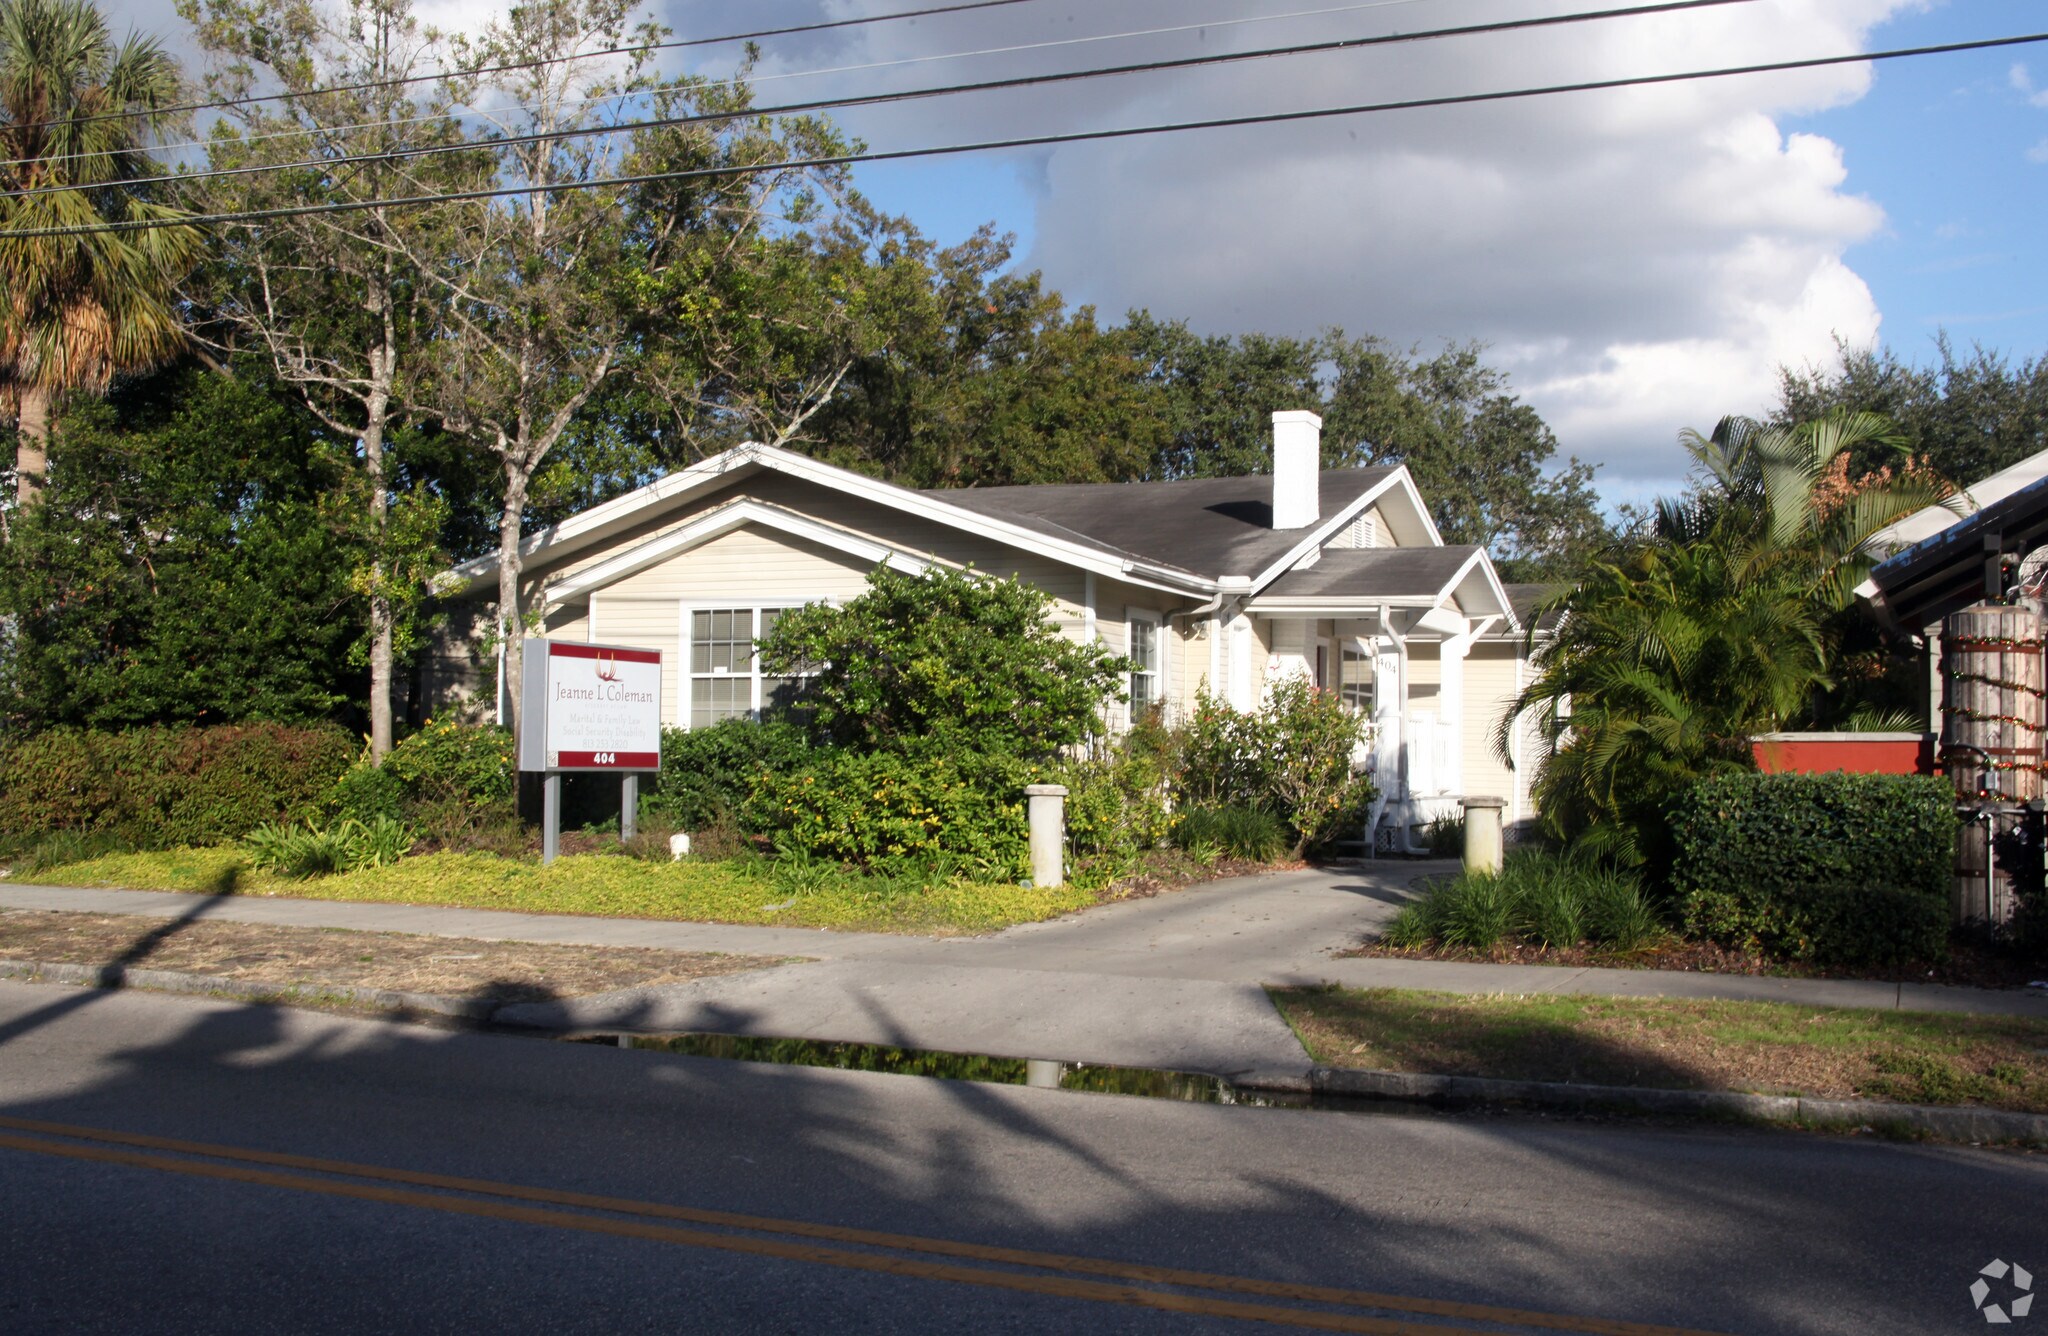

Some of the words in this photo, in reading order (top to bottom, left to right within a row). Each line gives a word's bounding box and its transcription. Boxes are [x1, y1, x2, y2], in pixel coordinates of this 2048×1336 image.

[1377, 658, 1396, 674] 404
[556, 682, 594, 702] Jeanne
[597, 684, 604, 701] L
[607, 683, 653, 703] Coleman
[569, 712, 595, 723] Marital
[597, 714, 603, 723] &
[604, 713, 627, 726] Family
[628, 715, 641, 725] Law
[562, 725, 584, 736] Social
[585, 726, 614, 738] Security
[615, 726, 646, 740] Disability
[582, 739, 594, 749] 813
[593, 752, 615, 764] 404
